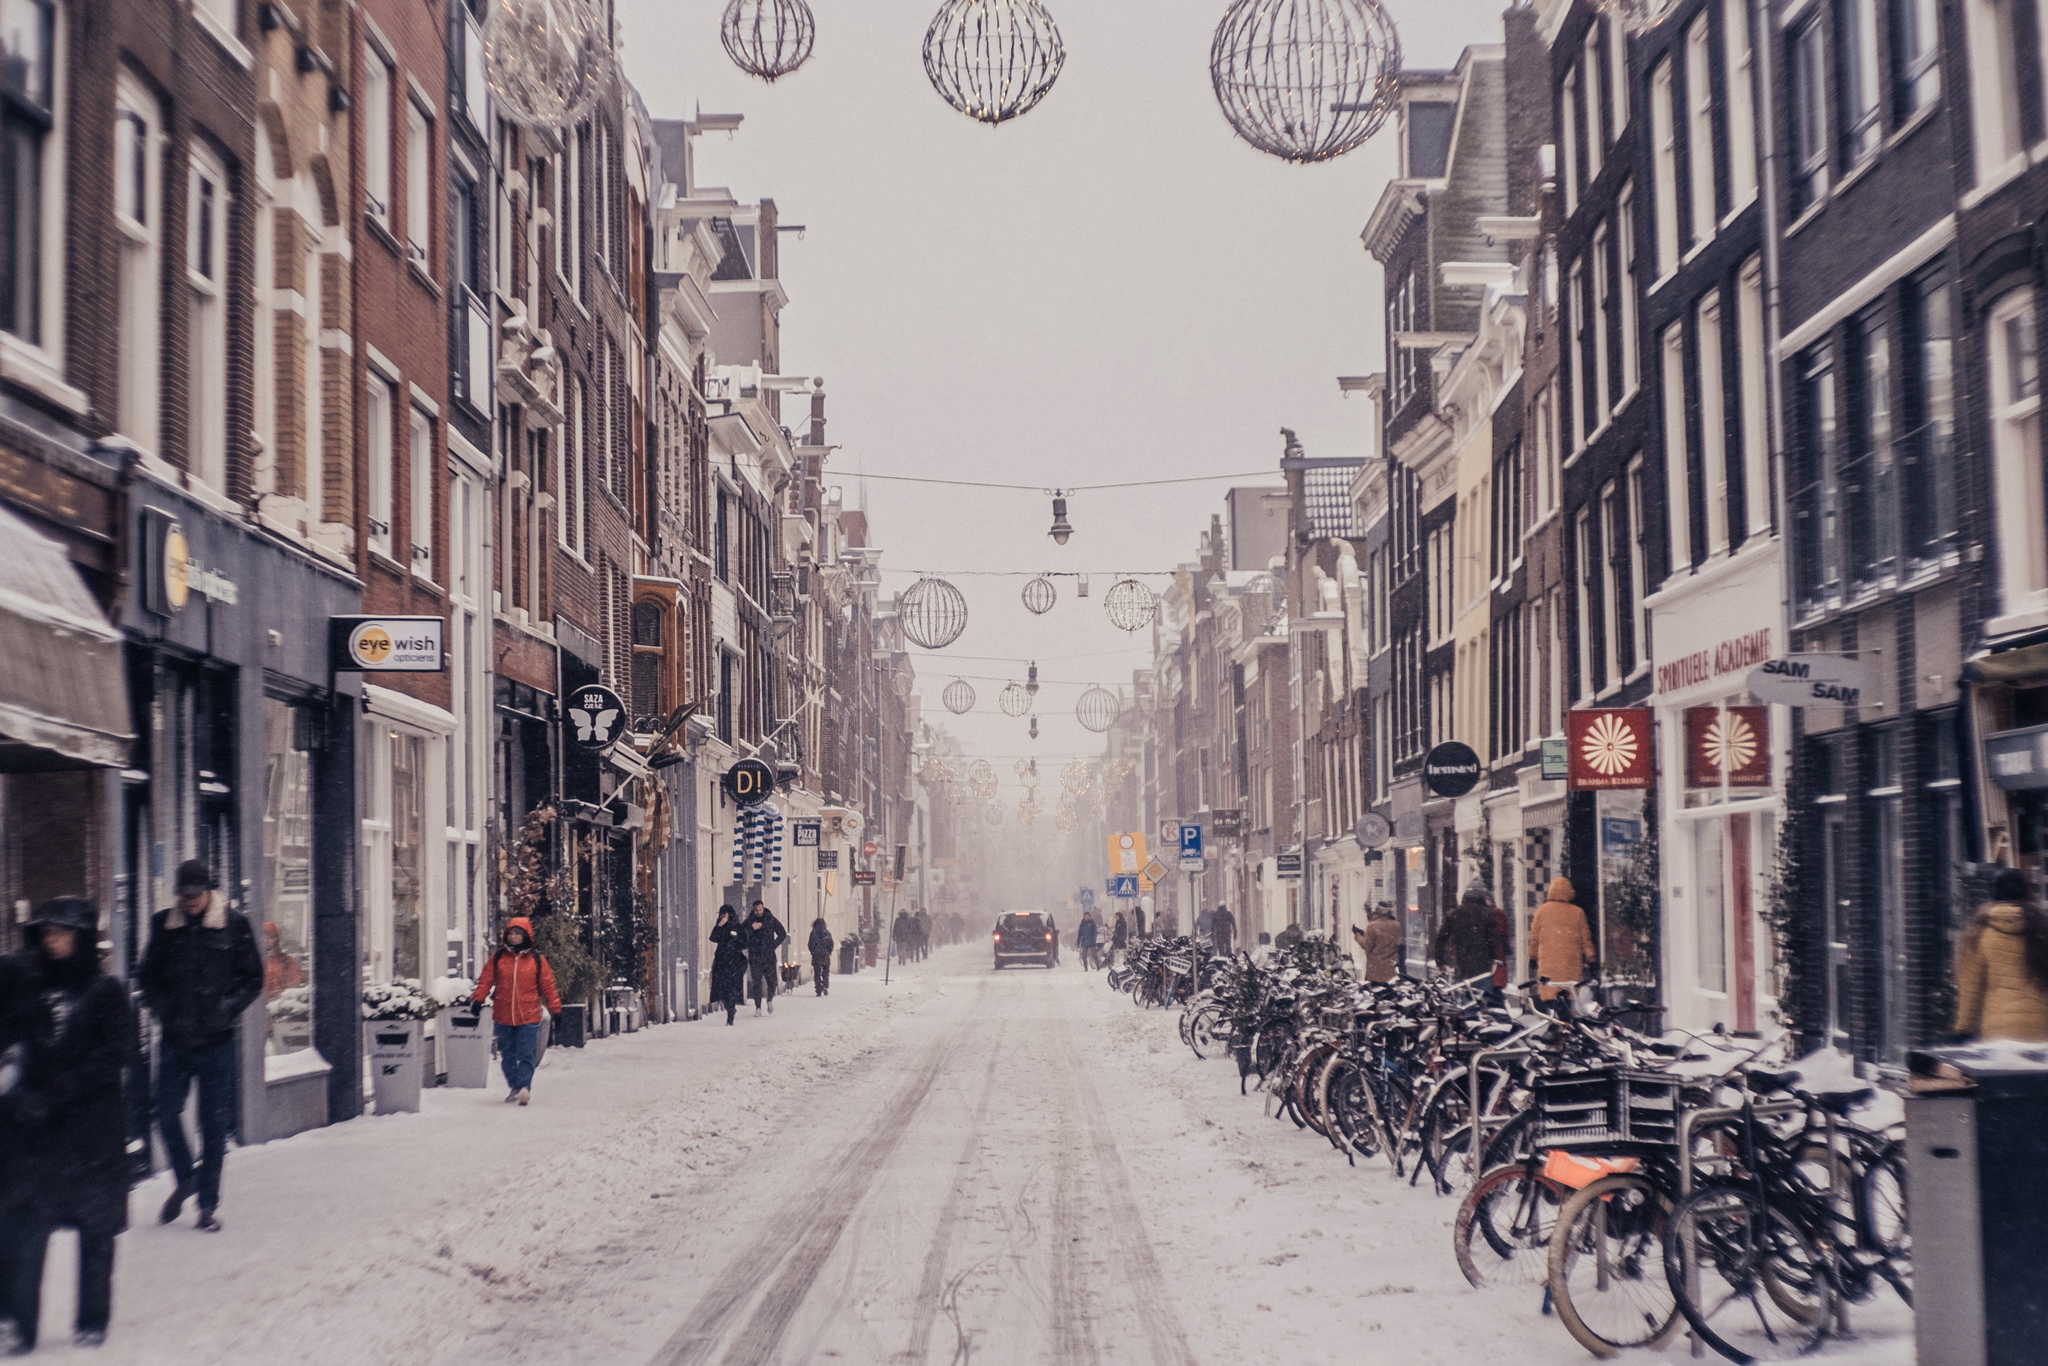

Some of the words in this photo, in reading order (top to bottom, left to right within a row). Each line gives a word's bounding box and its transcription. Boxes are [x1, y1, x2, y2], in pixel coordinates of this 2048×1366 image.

[359, 639, 389, 655] eye
[394, 636, 435, 651] wish
[393, 653, 435, 663] opticiens
[1658, 650, 1708, 694] SPIRITUELE
[1714, 627, 1770, 676] ACADEMIE
[1762, 660, 1810, 678] SAM
[583, 694, 604, 703] SAZA
[1812, 683, 1860, 701] SAM
[1184, 827, 1198, 846] P
[1108, 880, 1116, 890] P
